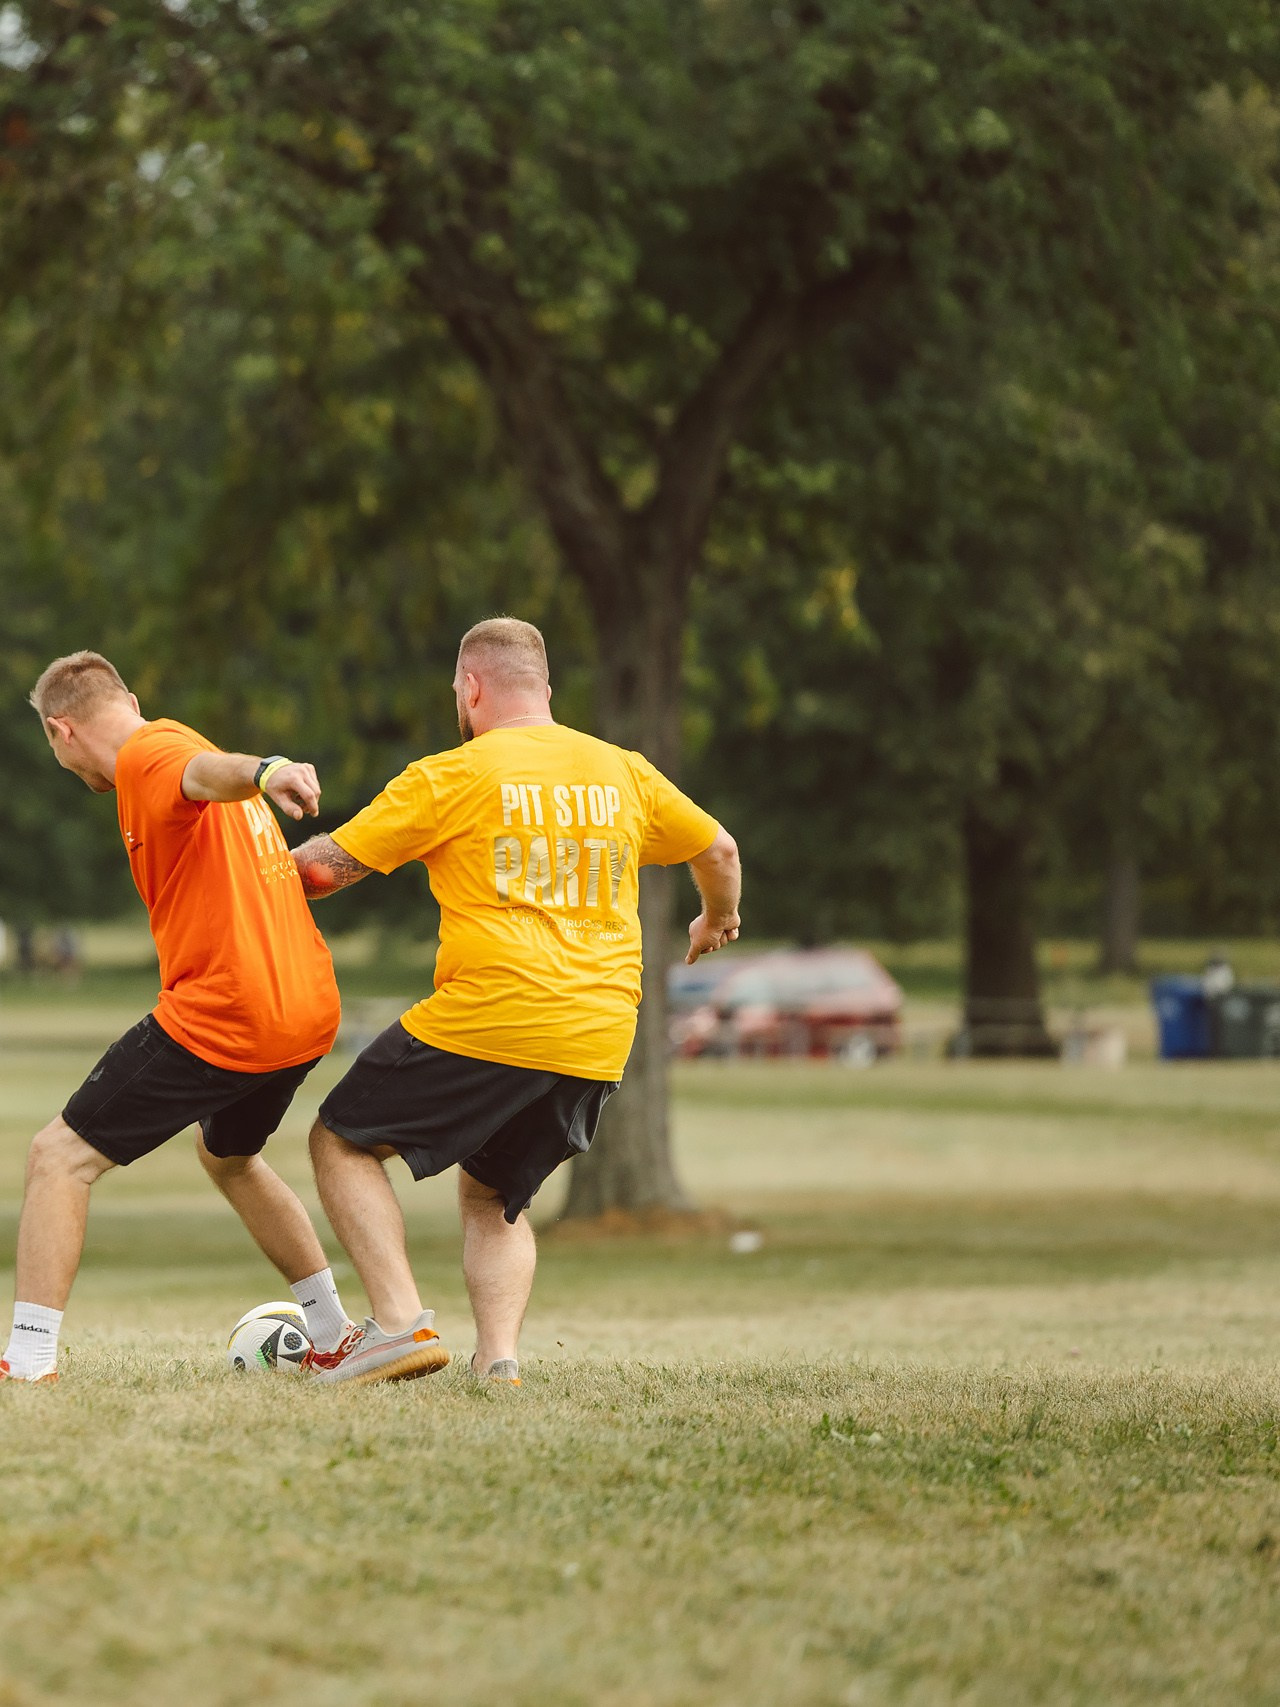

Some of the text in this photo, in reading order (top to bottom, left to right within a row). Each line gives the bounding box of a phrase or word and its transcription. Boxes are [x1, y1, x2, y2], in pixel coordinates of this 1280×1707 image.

[500, 783, 621, 828] PIT STOP
[493, 835, 631, 909] PARTY
[561, 917, 602, 929] TRUCKS
[605, 920, 628, 931] REST
